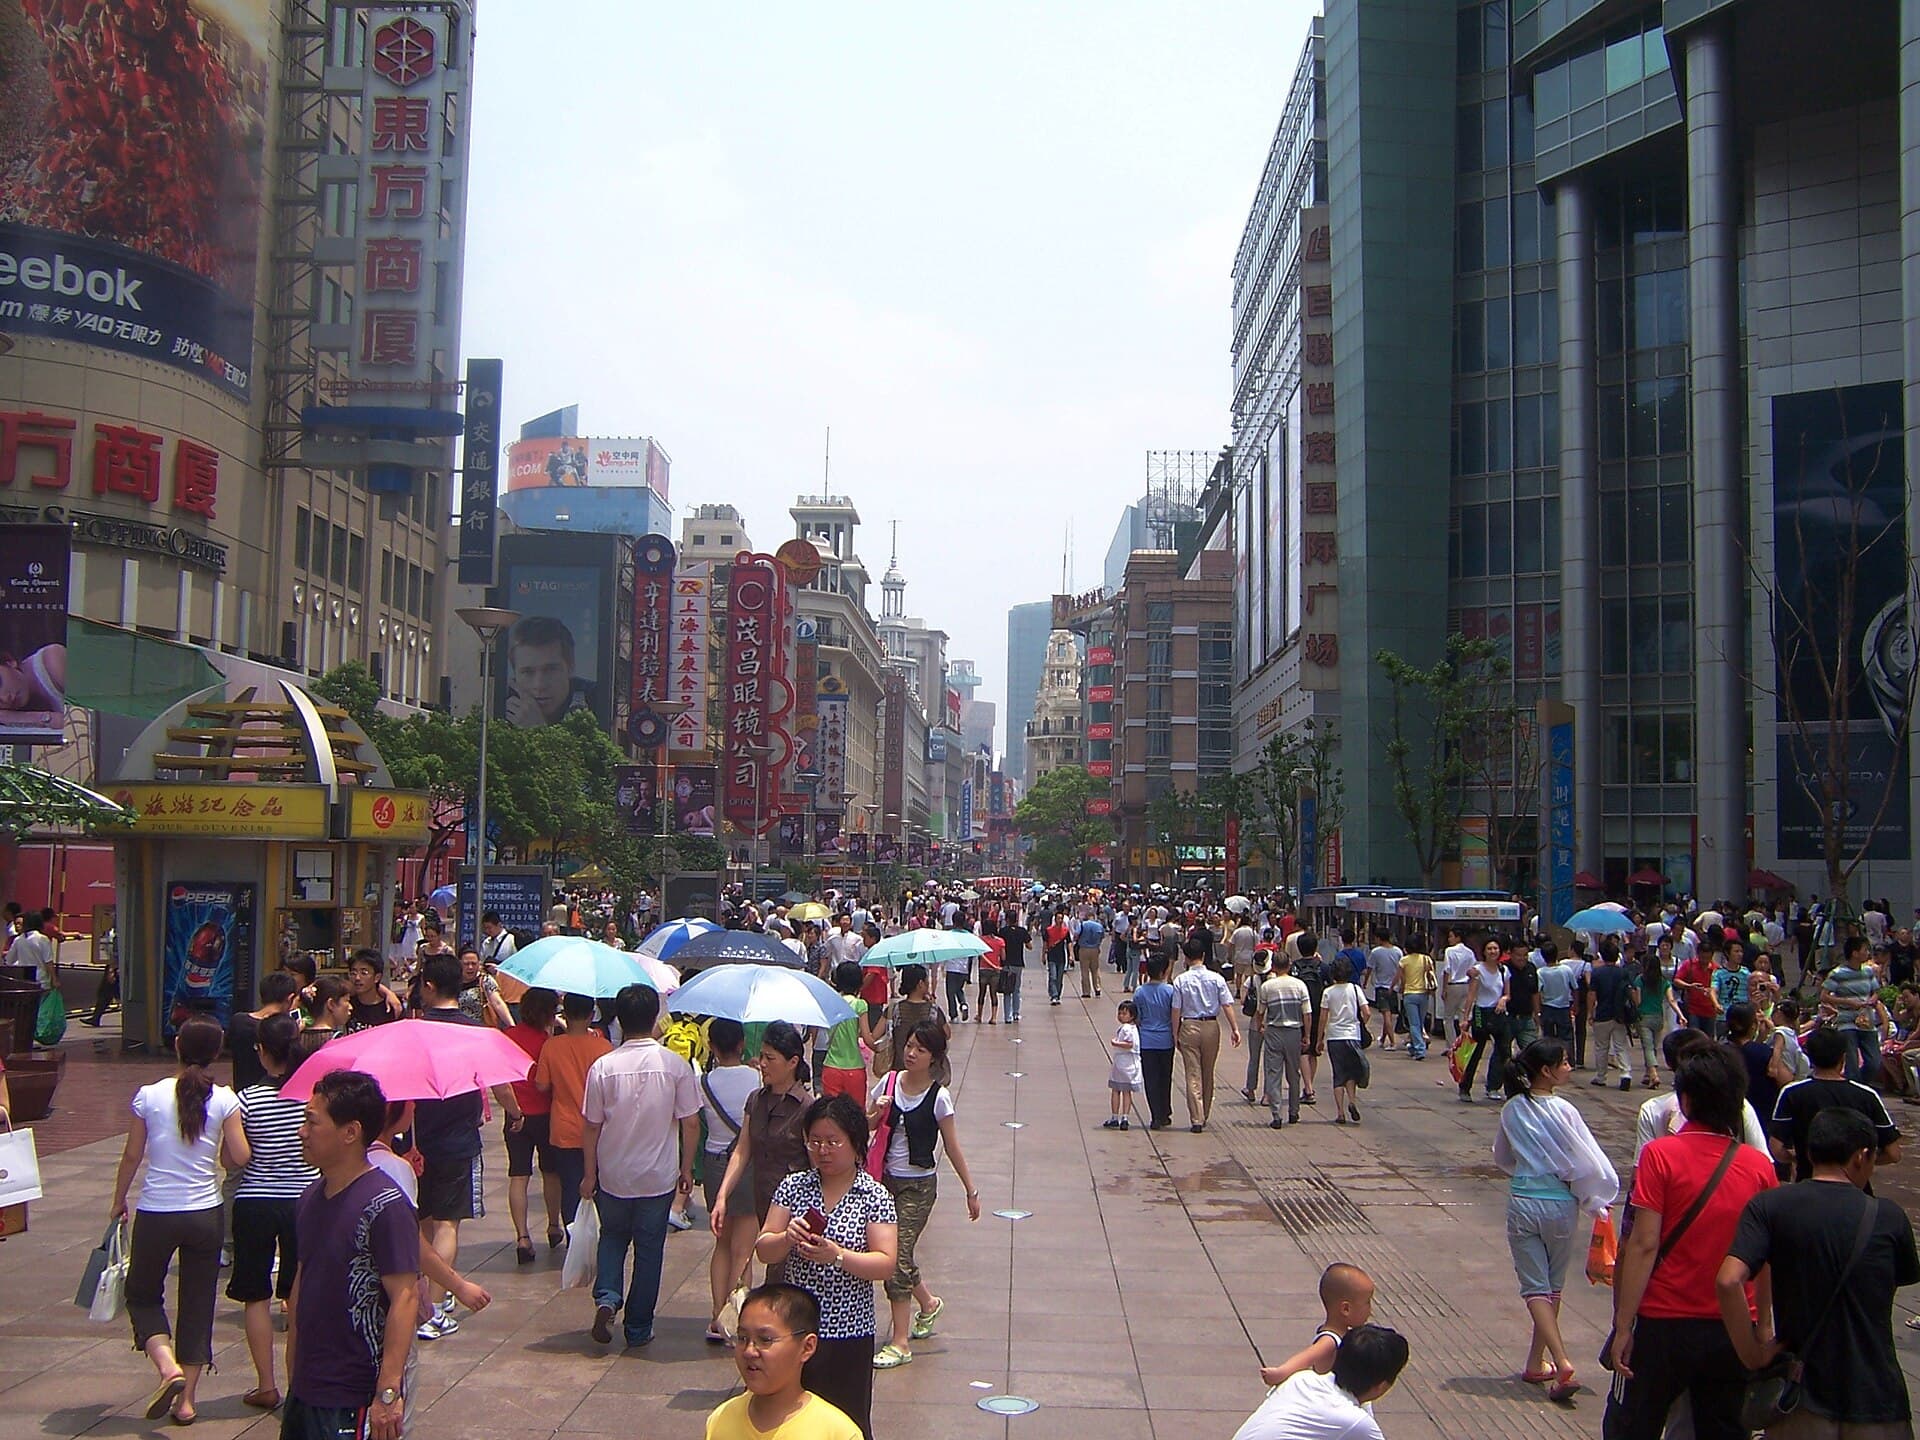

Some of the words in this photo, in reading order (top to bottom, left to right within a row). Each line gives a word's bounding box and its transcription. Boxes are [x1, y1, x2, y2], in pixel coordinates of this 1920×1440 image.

[358, 96, 431, 366] 東方商厦
[0, 411, 219, 520] 方商厦
[465, 421, 492, 531] 交通銀行
[1305, 284, 1338, 667] 百联世茂国际广场
[674, 598, 701, 748] 上海泰康食品公司
[732, 616, 763, 789] 茂昌眼镜公司
[143, 792, 284, 817] 旅游纪念品
[185, 893, 232, 903] PEPSI
